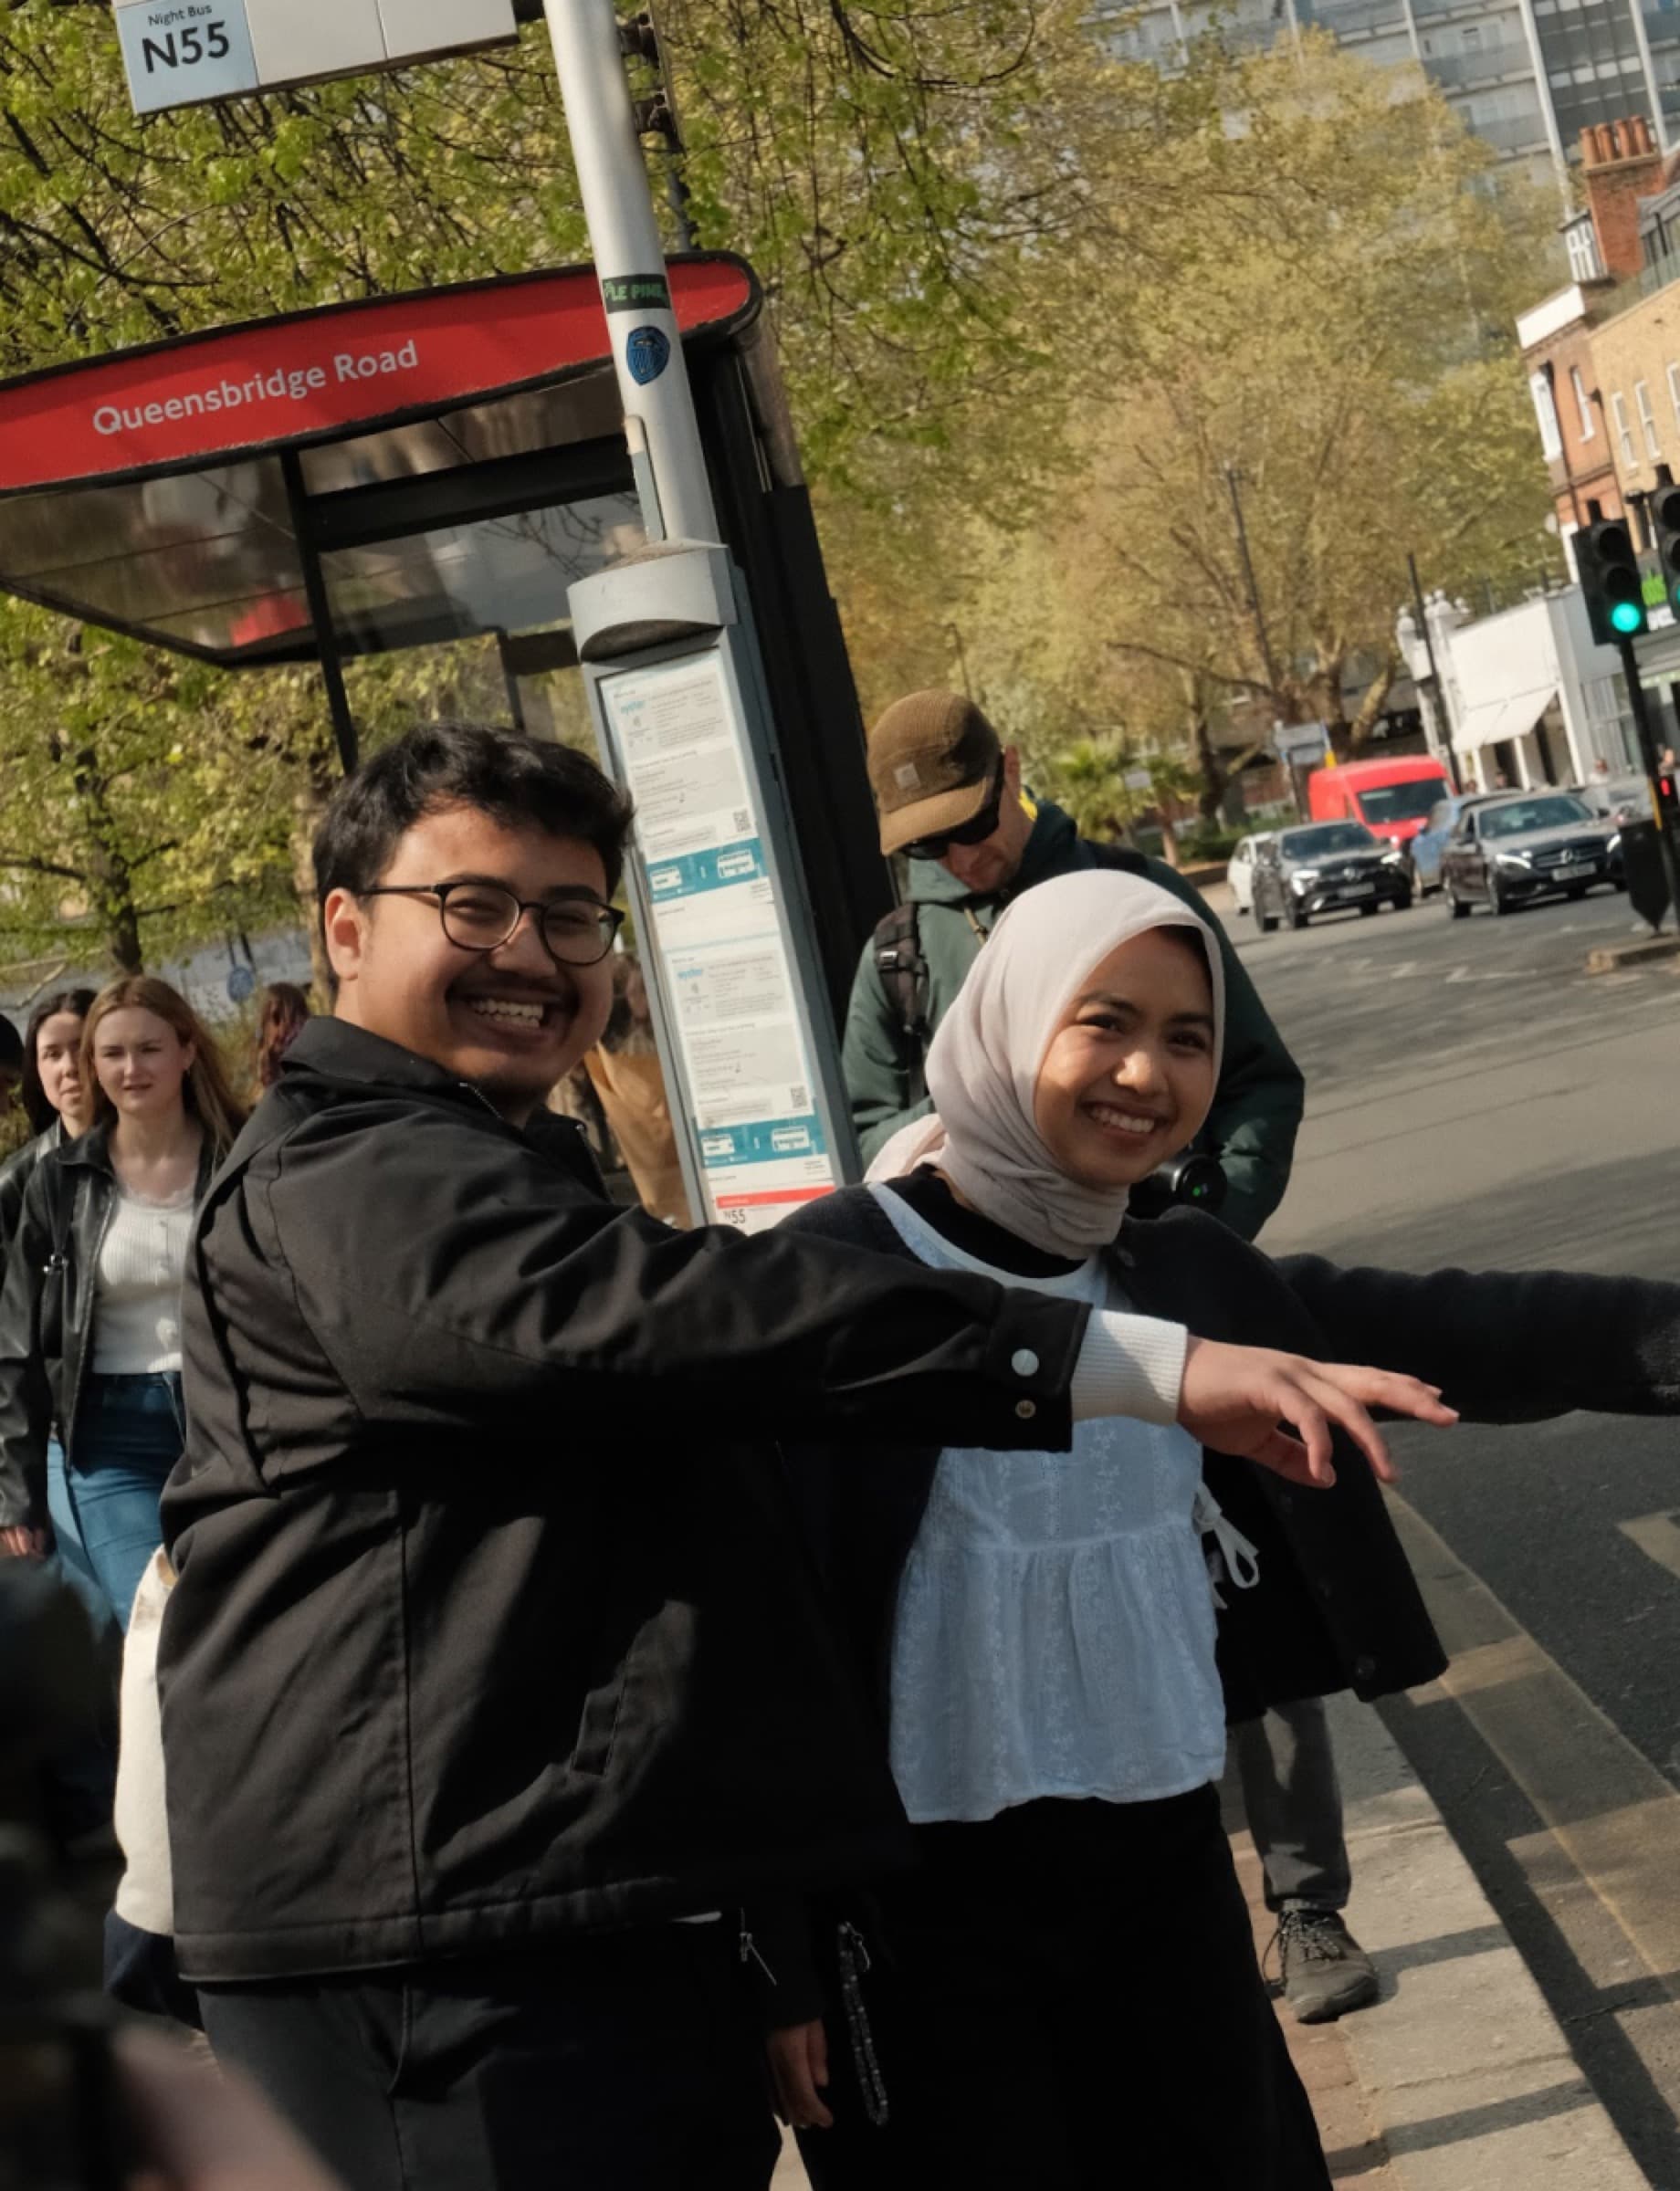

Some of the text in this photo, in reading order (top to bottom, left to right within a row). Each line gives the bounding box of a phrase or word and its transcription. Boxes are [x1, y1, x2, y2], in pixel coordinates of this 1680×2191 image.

[148, 5, 213, 26] Night Bus
[142, 20, 229, 73] N55
[92, 340, 419, 435] Queensbridge Road
